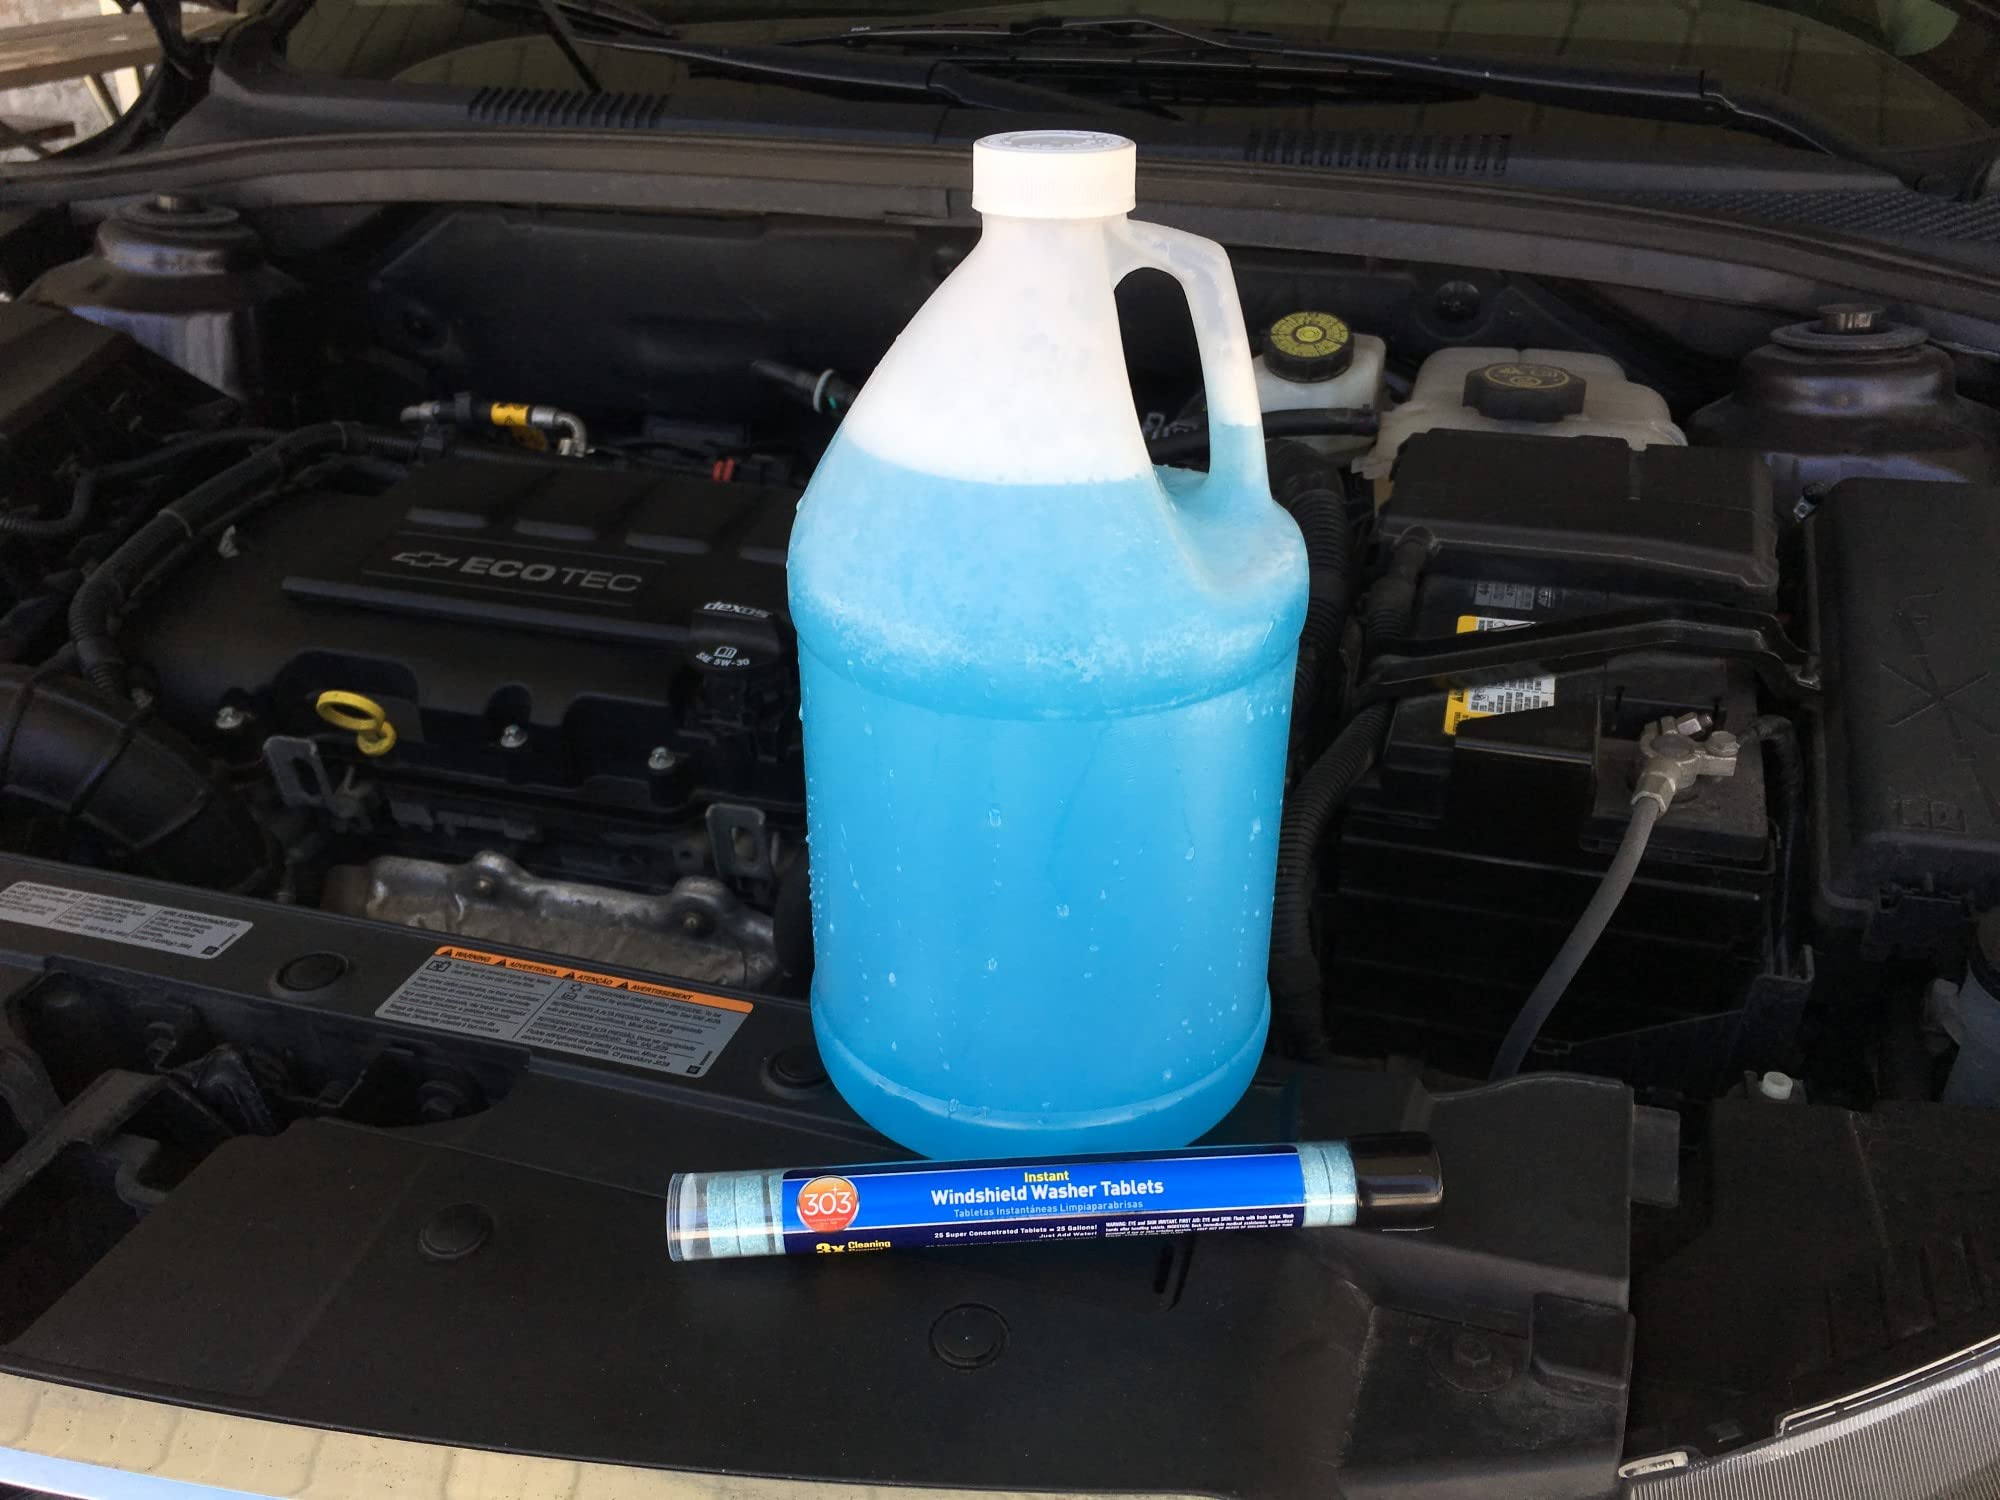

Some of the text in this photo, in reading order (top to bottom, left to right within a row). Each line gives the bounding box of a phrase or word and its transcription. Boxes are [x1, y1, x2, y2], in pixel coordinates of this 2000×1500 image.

[459, 556, 643, 592] ECOTEC
[703, 601, 772, 618] dexos
[713, 658, 750, 667] 5W-30
[455, 951, 492, 962] WARNING
[630, 984, 695, 1001] AVERTISSEMENT
[1024, 1170, 1070, 1183] Instant
[931, 1180, 1164, 1206] Windshield Washer Tablets
[803, 1191, 852, 1216] 303
[954, 1200, 1144, 1218] Tabletas Instantáneas Limpiaparabrisas
[946, 1231, 967, 1239] Super
[969, 1228, 1019, 1237] Concentrated
[1020, 1226, 1048, 1234] Tablets
[1067, 1224, 1098, 1232] Gallons!
[847, 1240, 891, 1249] Cleaning
